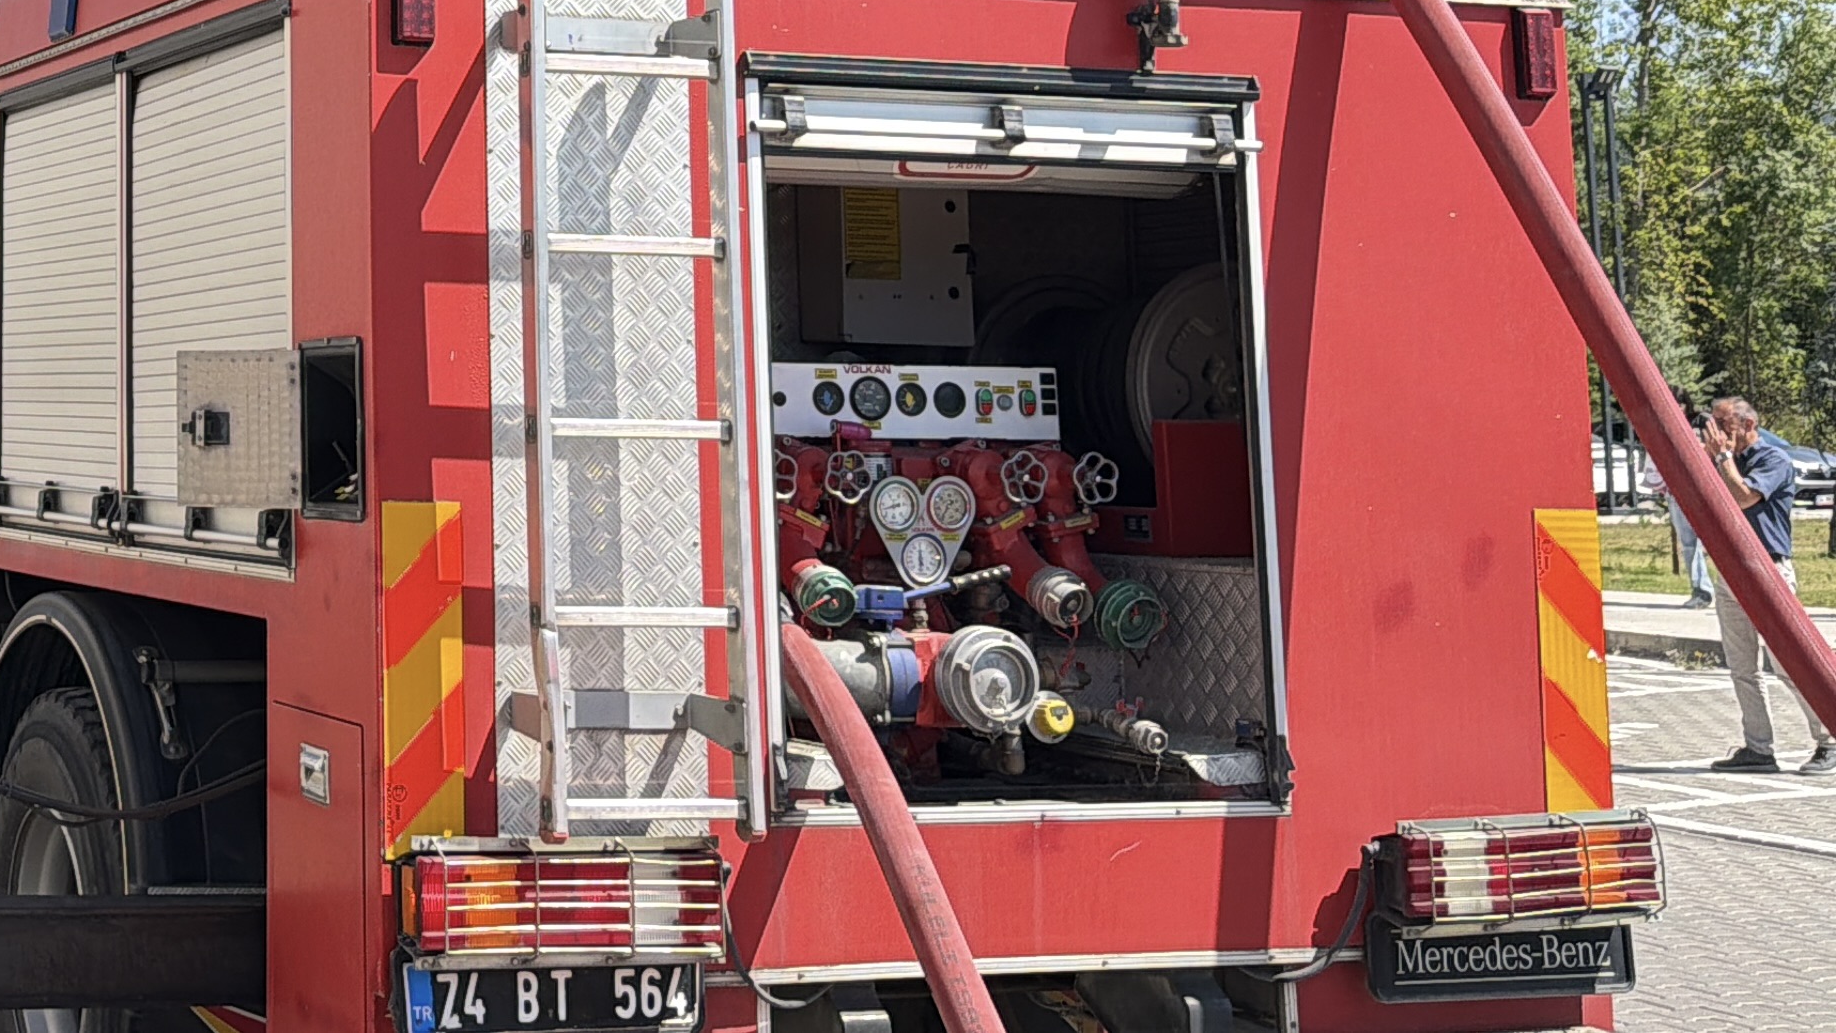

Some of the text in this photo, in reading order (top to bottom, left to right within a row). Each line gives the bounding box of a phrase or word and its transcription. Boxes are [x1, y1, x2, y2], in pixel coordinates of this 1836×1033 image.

[843, 364, 891, 374] VOLKAN
[1395, 934, 1612, 975] Mercedes-Benz
[413, 1005, 433, 1022] TR
[517, 969, 572, 1024] BT
[614, 967, 687, 1019] 564
